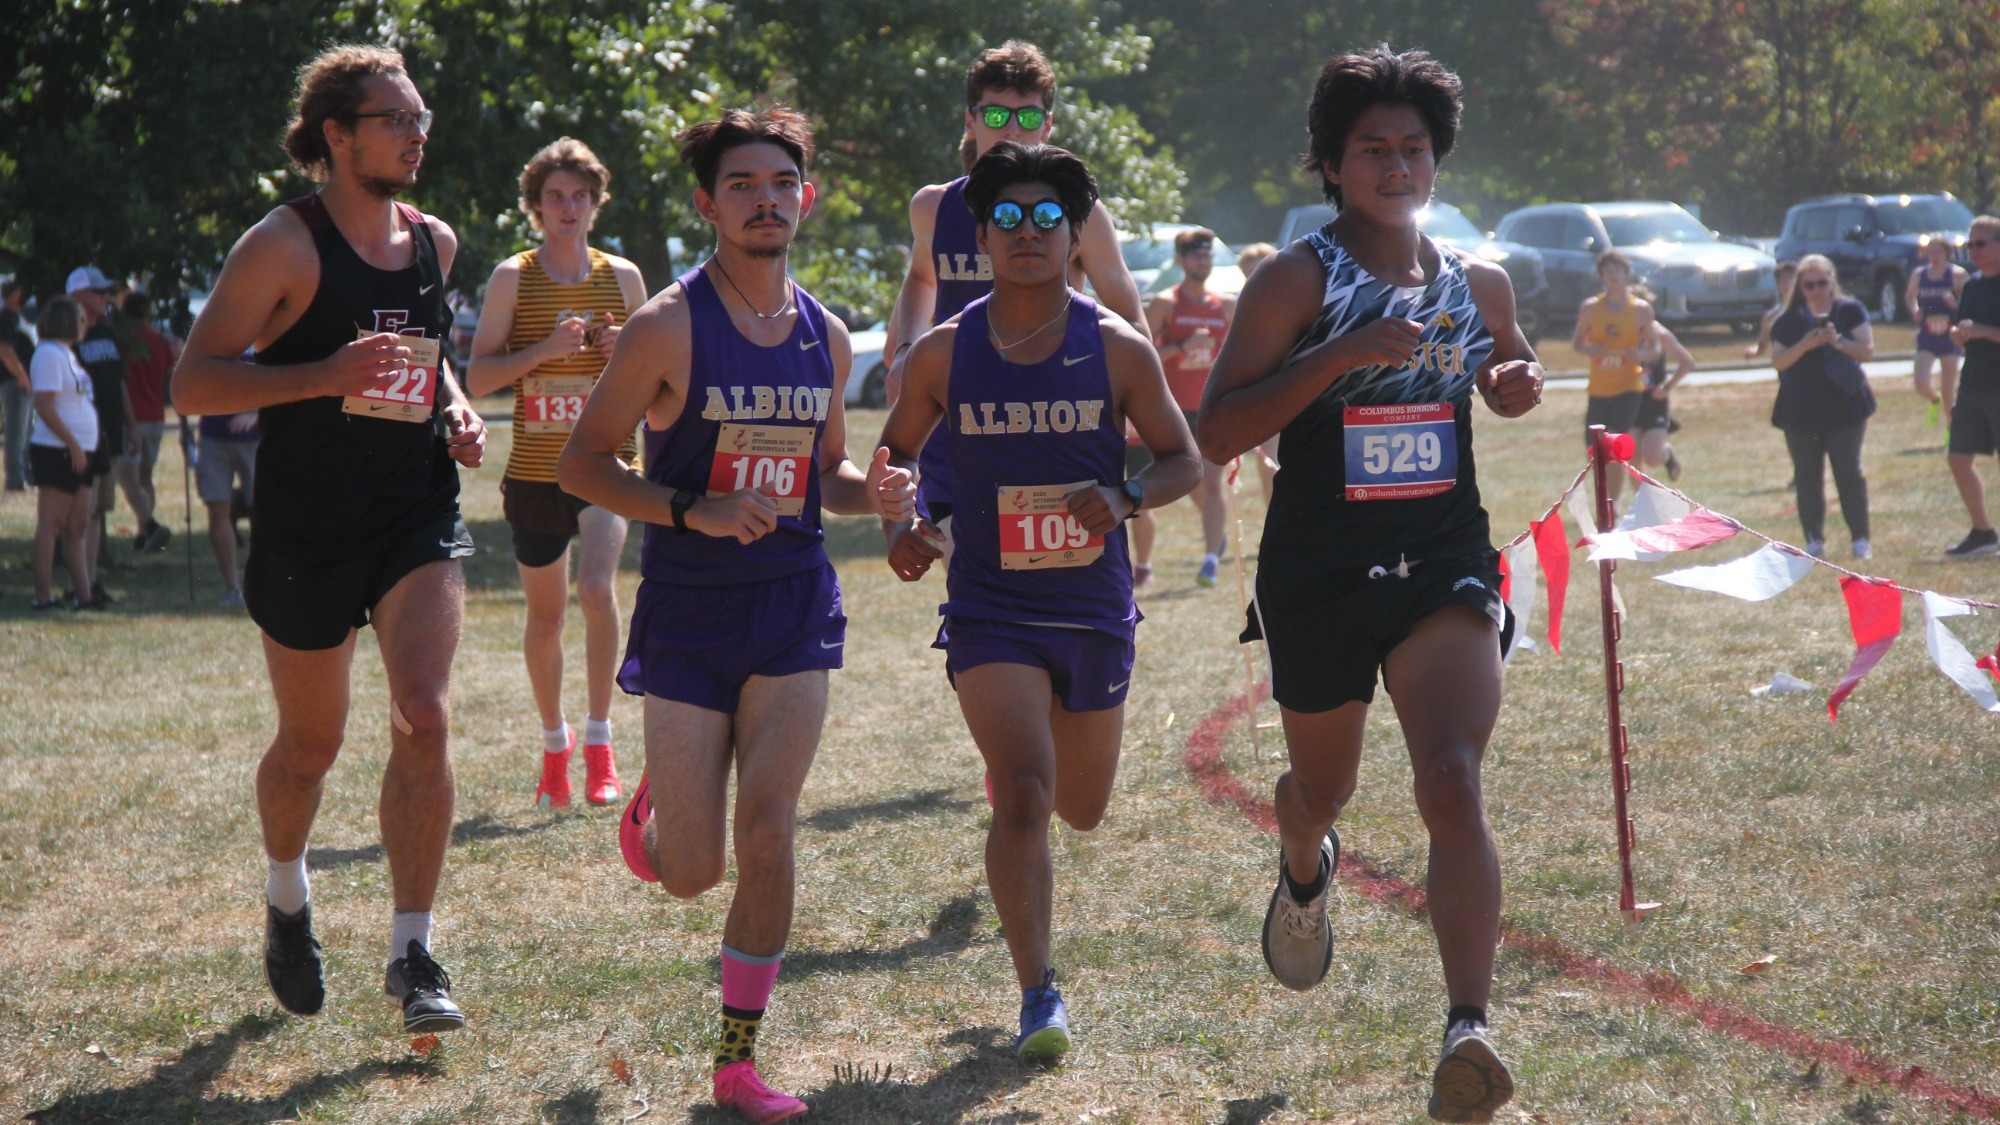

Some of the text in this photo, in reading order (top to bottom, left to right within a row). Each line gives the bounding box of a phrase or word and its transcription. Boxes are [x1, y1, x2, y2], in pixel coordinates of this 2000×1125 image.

[938, 253, 994, 281] ALB
[362, 367, 427, 404] 22
[535, 396, 583, 421] 133
[701, 386, 832, 421] ALBION
[959, 400, 1104, 435] ALBION
[1359, 404, 1440, 416] COLUMBUS RUNNING
[1384, 414, 1421, 422] COMPANY
[1363, 431, 1442, 475] 529
[732, 457, 797, 496] 106
[1017, 514, 1089, 551] 109
